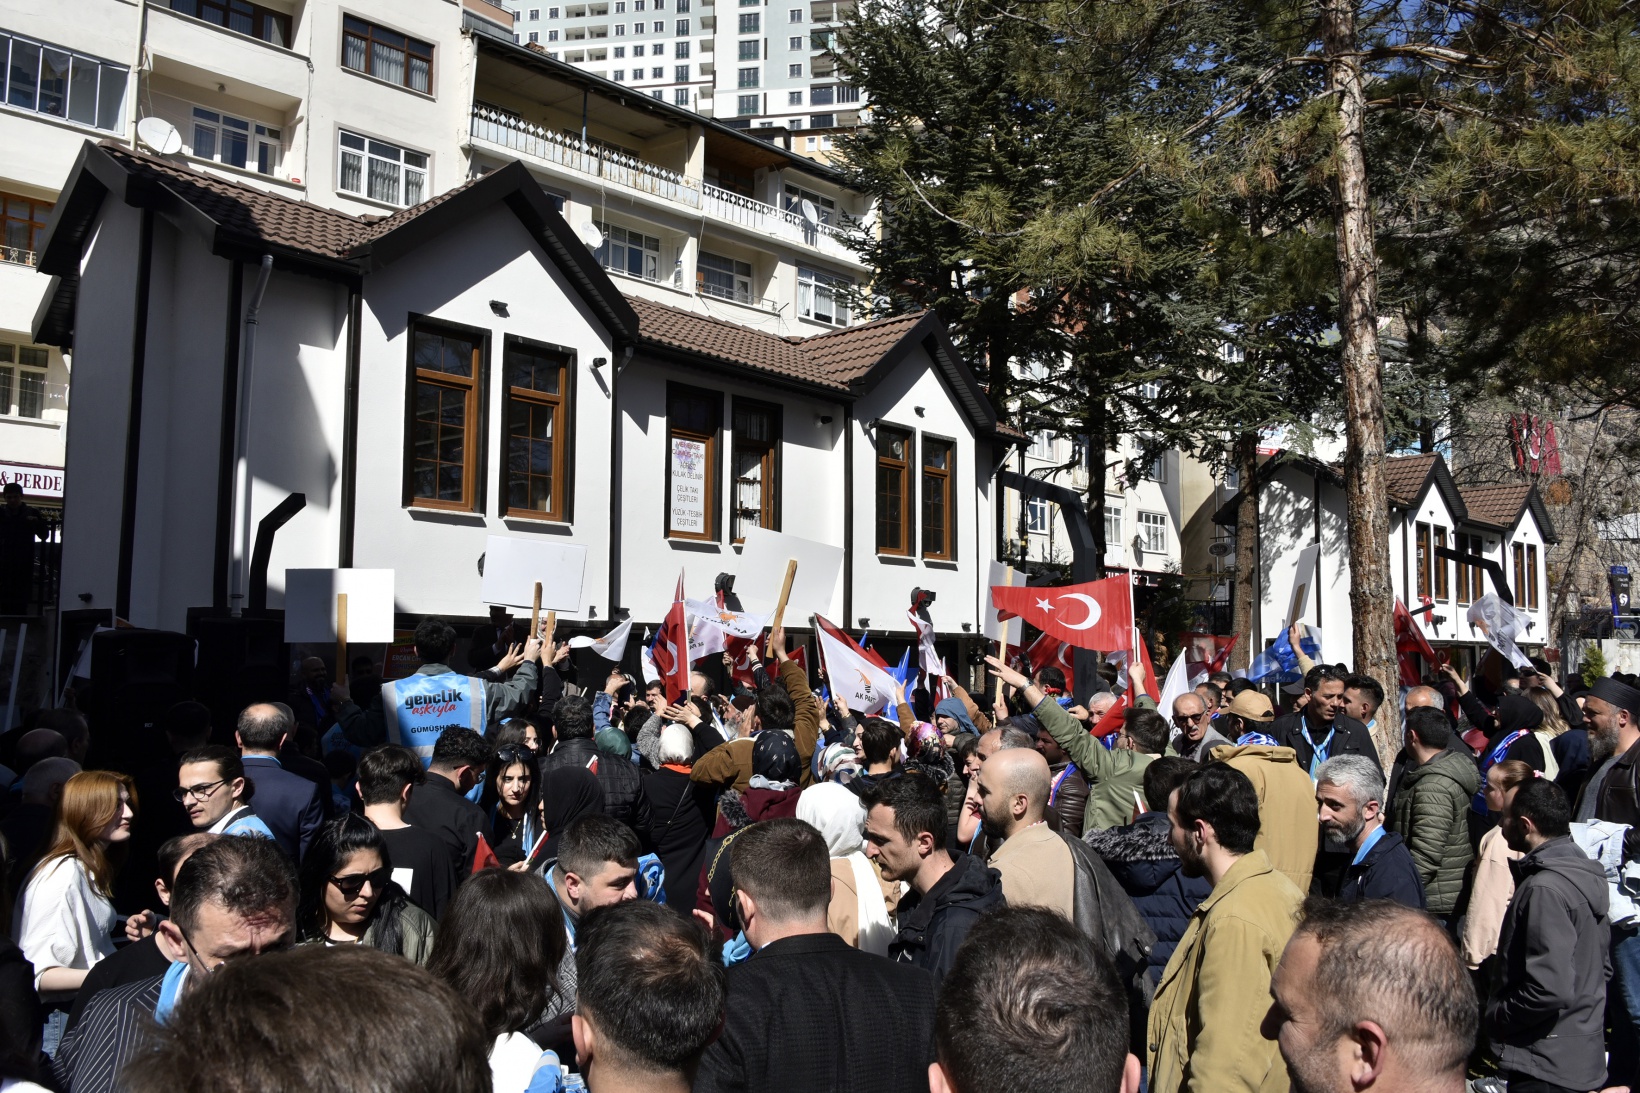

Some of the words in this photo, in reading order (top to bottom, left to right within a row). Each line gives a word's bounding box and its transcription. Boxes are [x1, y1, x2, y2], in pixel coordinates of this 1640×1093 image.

[14, 472, 62, 491] PERDE
[405, 689, 463, 709] gençlik
[855, 692, 864, 700] AK
[412, 700, 457, 717] aşkıyla
